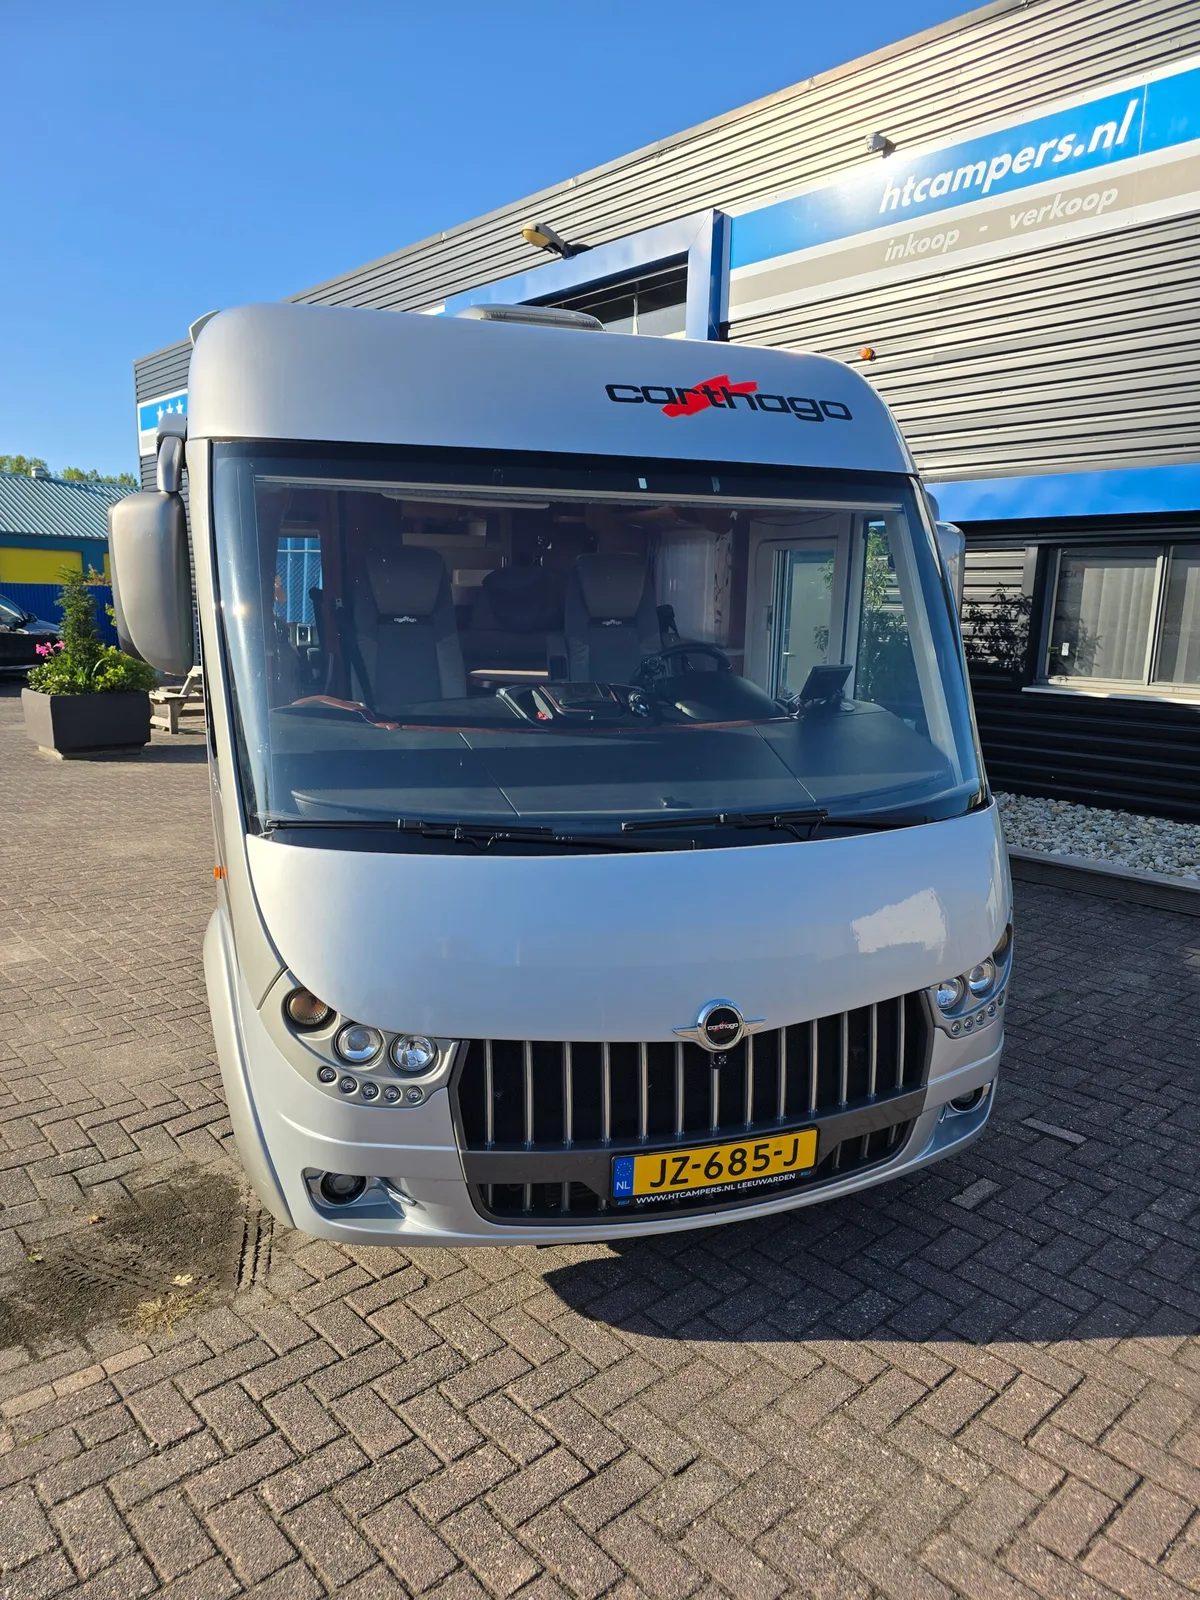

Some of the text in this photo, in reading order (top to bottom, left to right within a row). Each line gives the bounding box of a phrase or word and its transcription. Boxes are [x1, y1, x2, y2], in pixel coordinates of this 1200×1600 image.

[881, 98, 1138, 213] htcampers.nl
[884, 226, 960, 262] inkoop
[1009, 186, 1118, 231] verkoop
[605, 384, 853, 422] carthago
[616, 1180, 631, 1190] NL
[650, 1138, 799, 1188] JZ-685-J
[636, 1172, 796, 1204] WWW.HTCAMPERS.NL LEEUWARDEN
